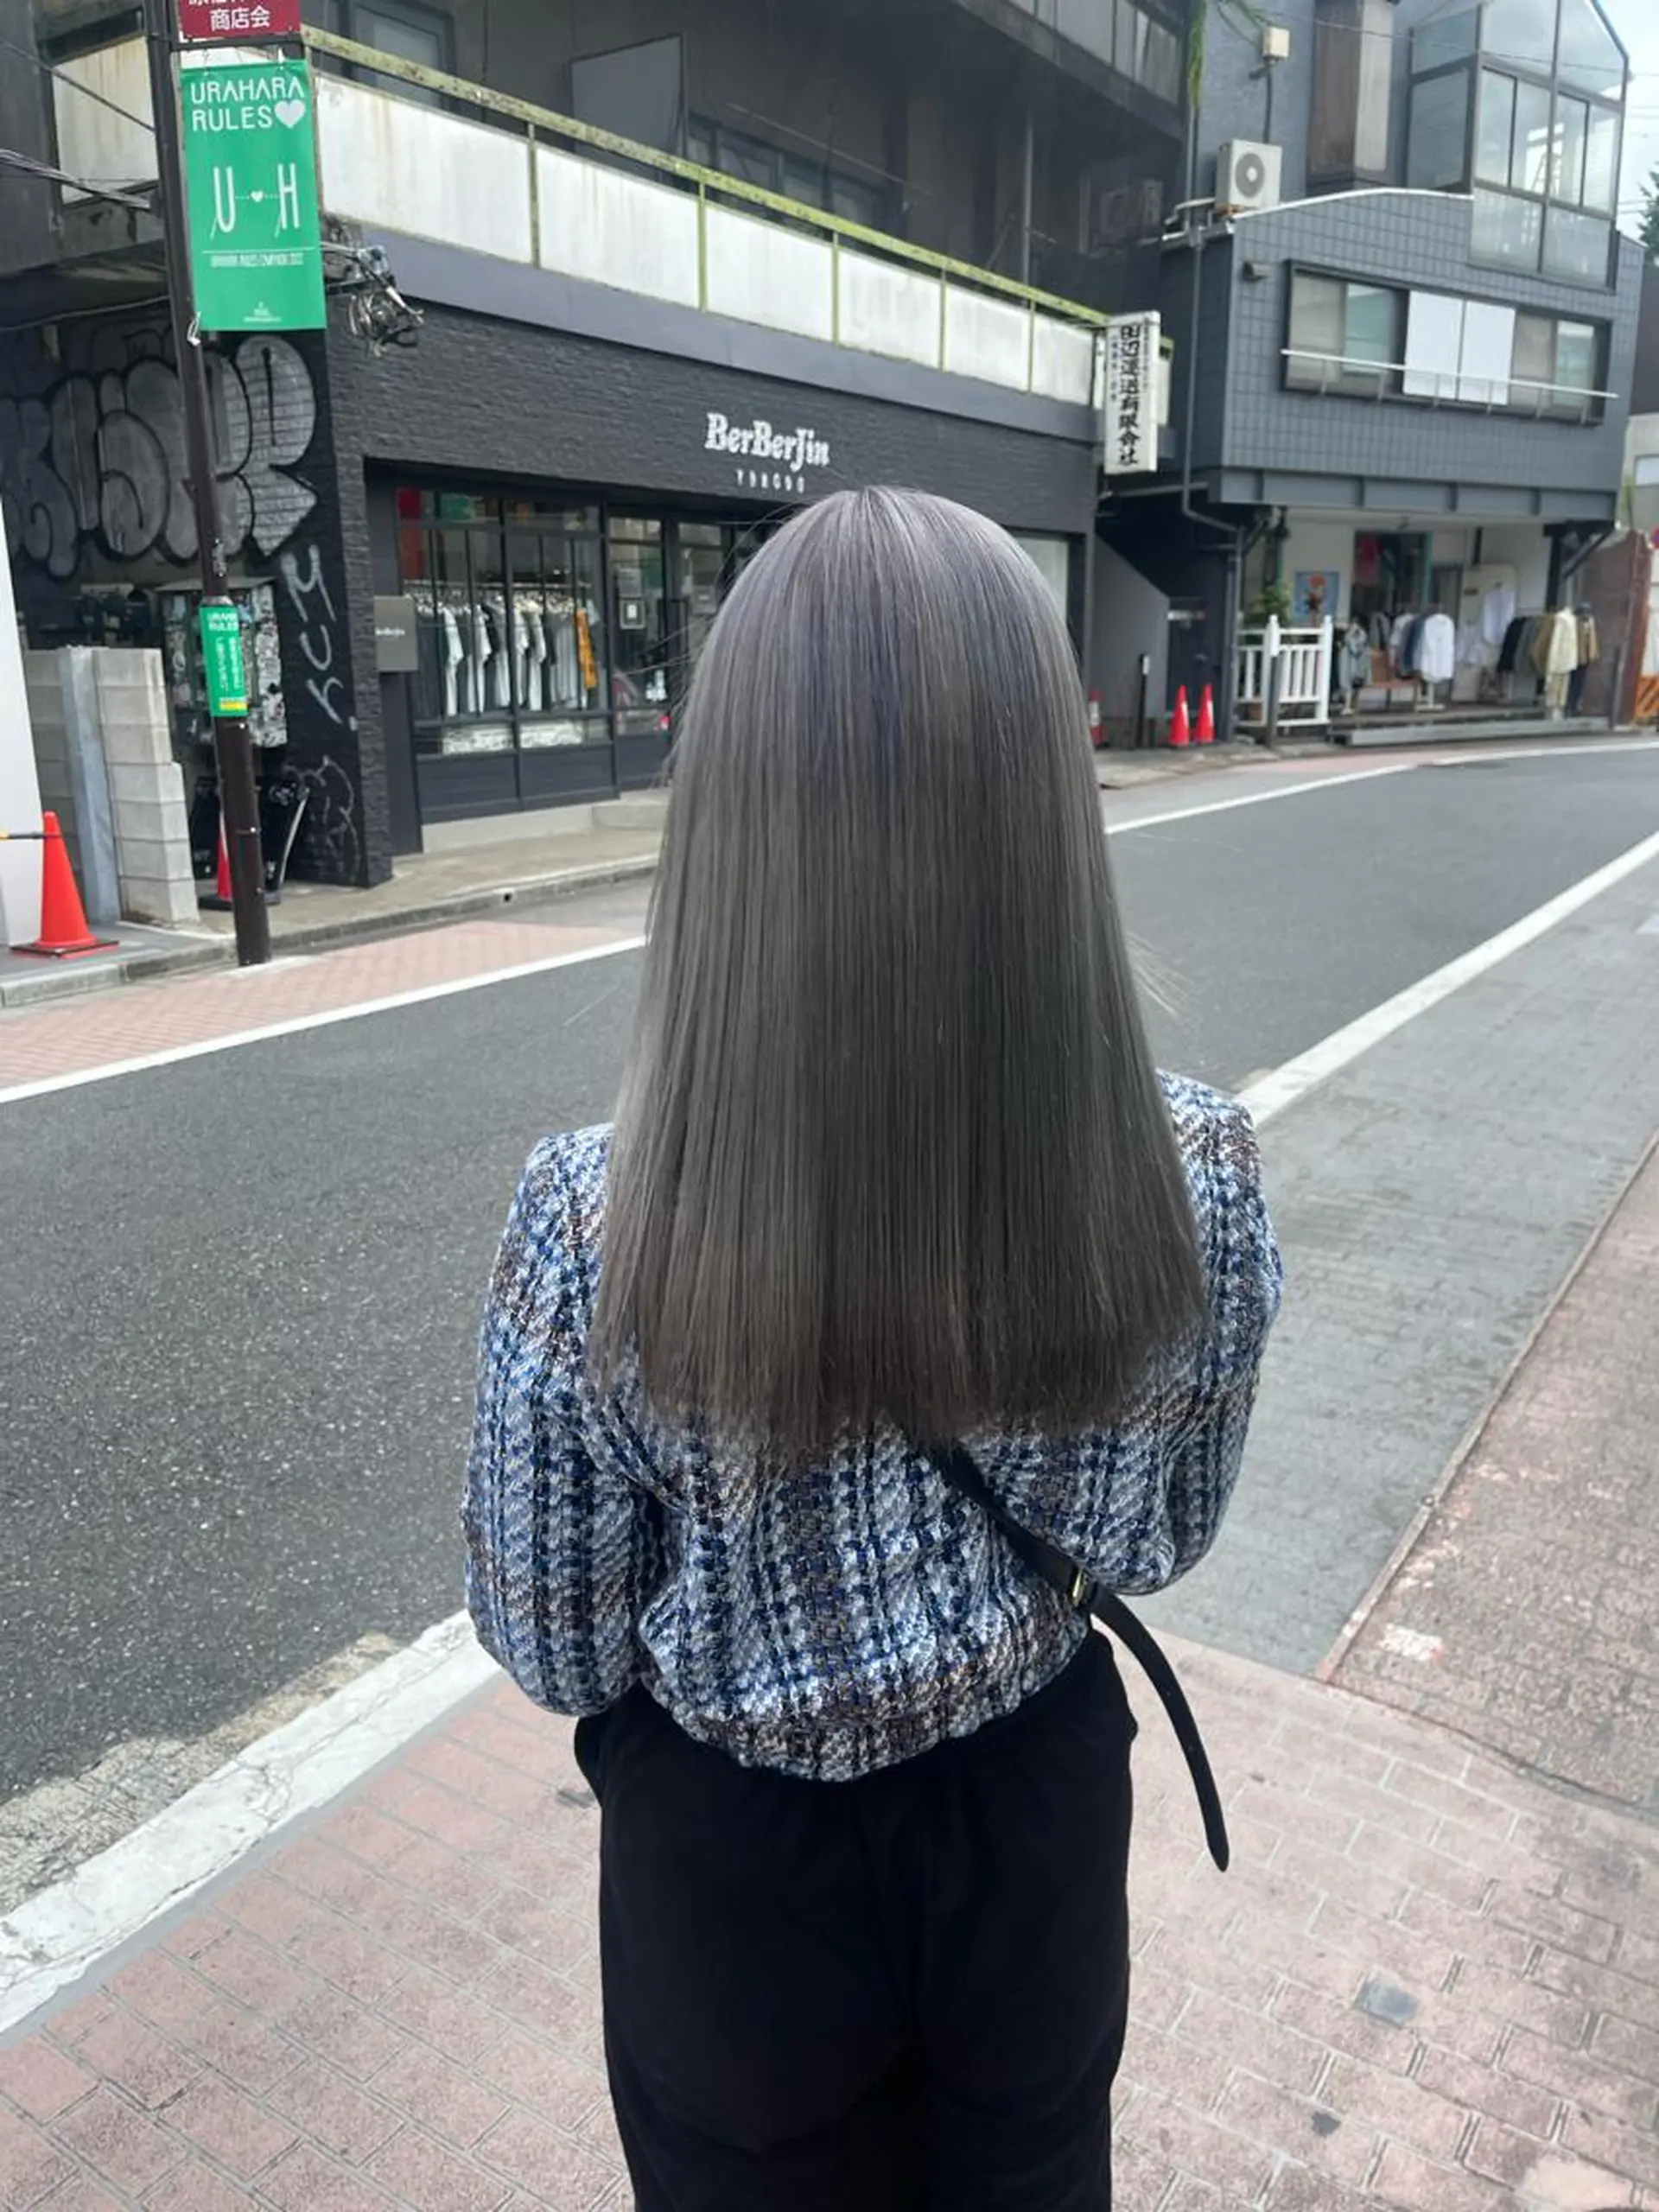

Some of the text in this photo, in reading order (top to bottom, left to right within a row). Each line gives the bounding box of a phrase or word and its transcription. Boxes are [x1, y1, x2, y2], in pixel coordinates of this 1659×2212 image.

[210, 5, 270, 31] 商店会
[190, 76, 305, 105] URAHARA
[192, 105, 273, 131] RULES
[704, 411, 830, 472] BerBerJin
